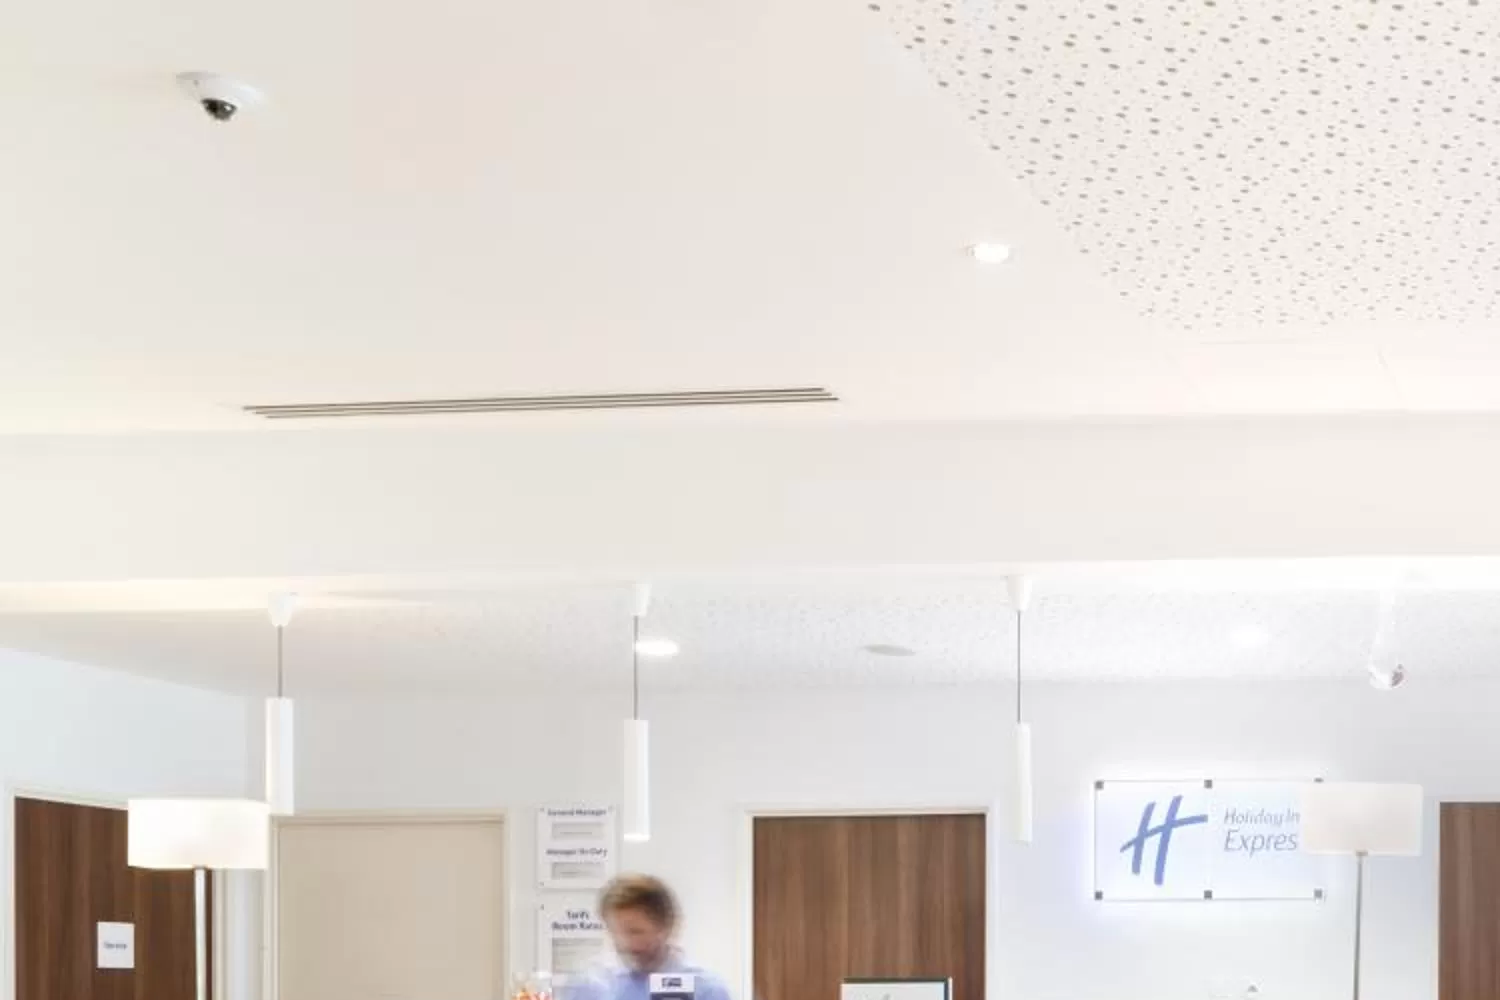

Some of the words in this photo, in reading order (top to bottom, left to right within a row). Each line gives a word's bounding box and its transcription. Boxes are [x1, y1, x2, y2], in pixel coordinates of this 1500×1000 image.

[1223, 808, 1283, 826] Holiday
[1285, 808, 1301, 824] In
[1223, 828, 1299, 858] Expres
